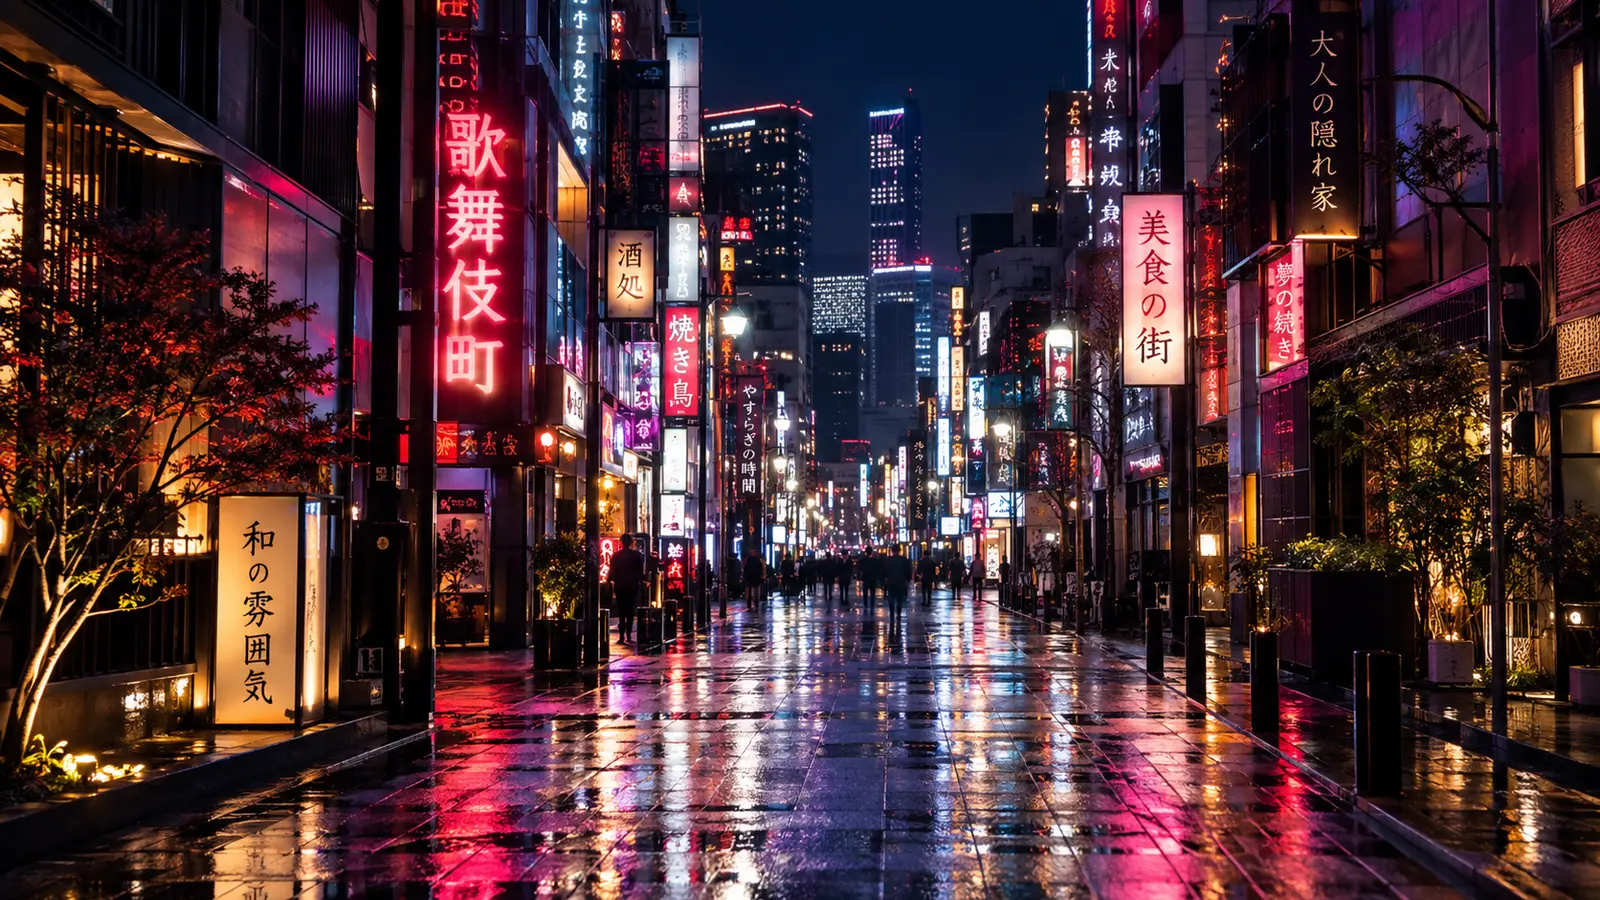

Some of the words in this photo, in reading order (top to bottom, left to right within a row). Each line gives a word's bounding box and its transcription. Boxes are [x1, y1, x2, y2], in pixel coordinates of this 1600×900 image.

[1310, 30, 1338, 212] 大人の隠れ家
[443, 113, 506, 394] 歌舞伎町
[617, 242, 644, 299] 酒処
[1136, 209, 1172, 364] 美食の街
[1274, 263, 1296, 359] 夢の続き
[669, 314, 696, 408] 焼き鳥
[741, 384, 757, 494] やすらぎの時間
[242, 520, 275, 705] 和の雰囲気
